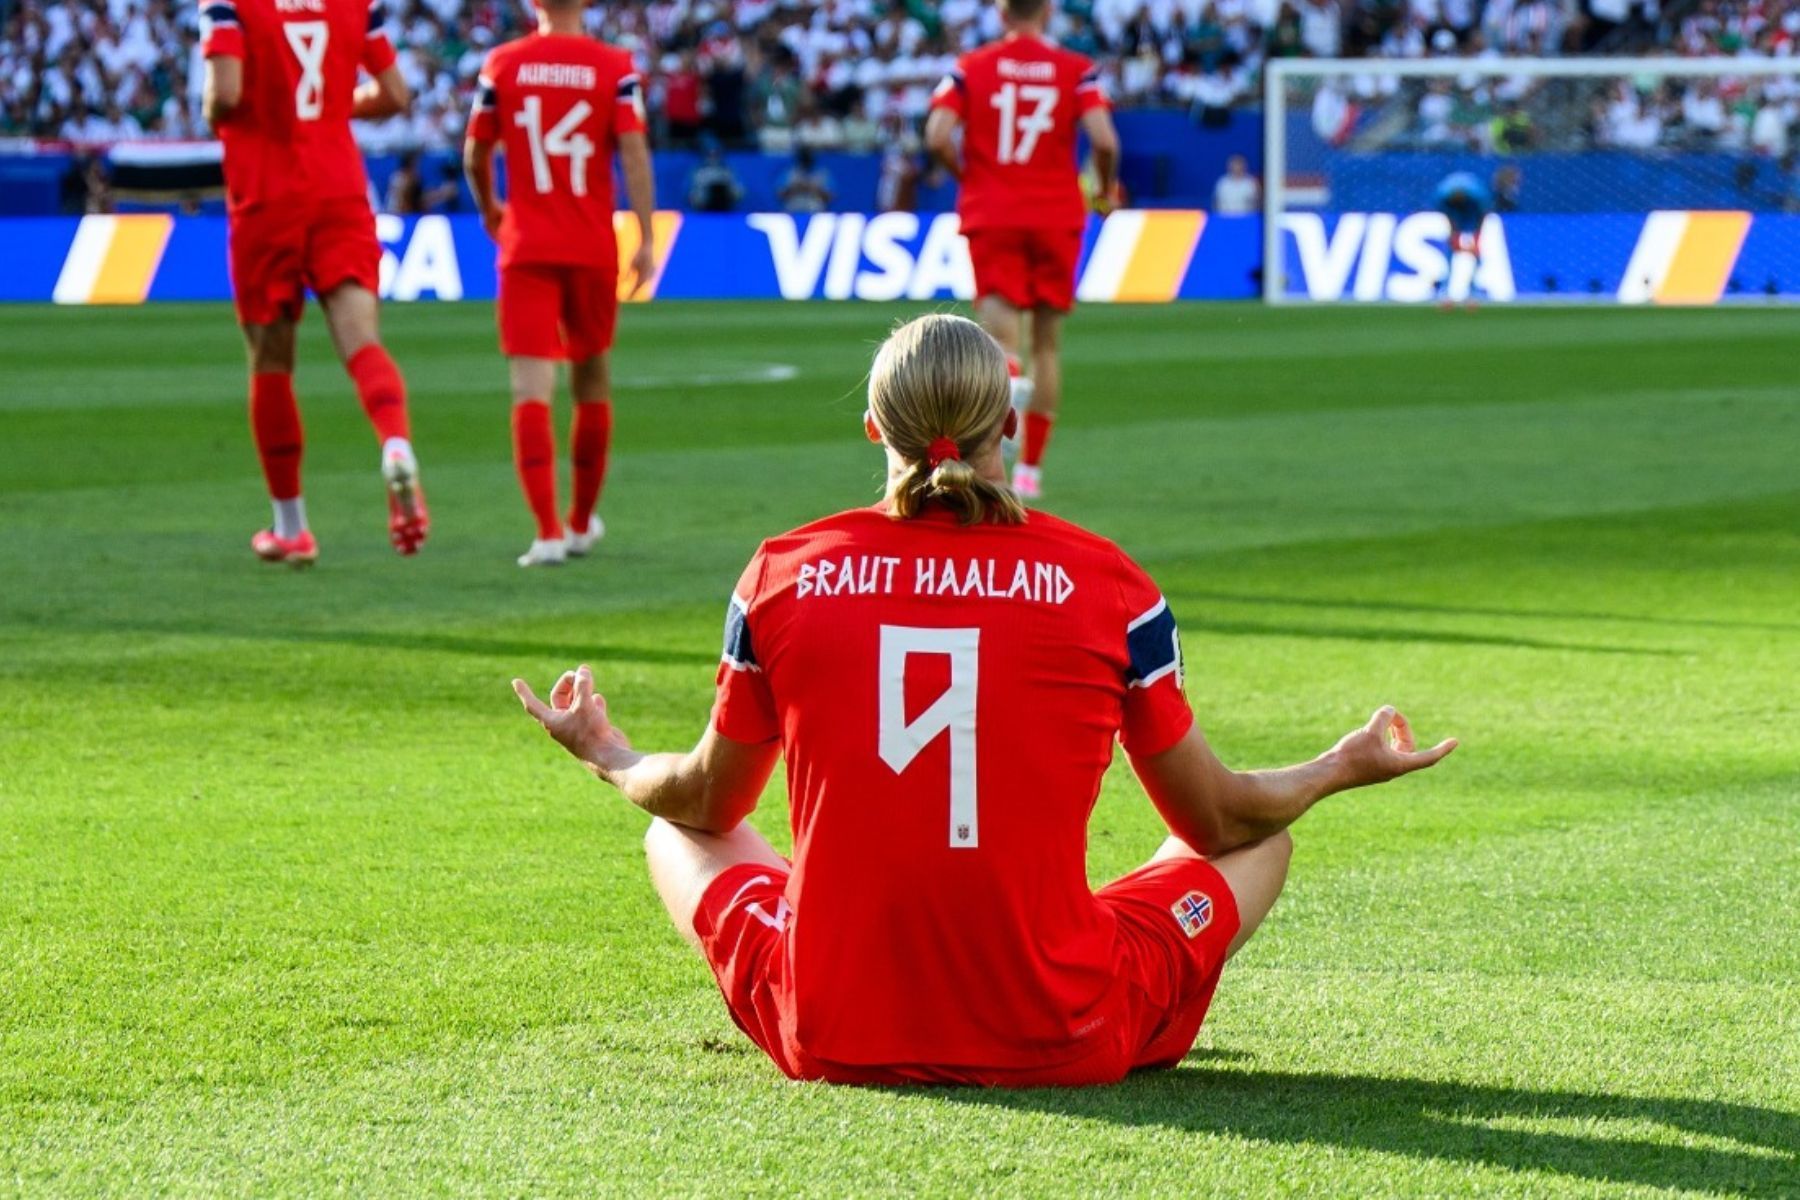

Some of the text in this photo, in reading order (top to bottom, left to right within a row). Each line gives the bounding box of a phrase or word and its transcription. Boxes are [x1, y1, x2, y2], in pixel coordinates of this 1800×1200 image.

[283, 20, 329, 121] 8
[514, 95, 595, 197] 14
[990, 82, 1060, 164] 17
[747, 211, 977, 301] VISA
[796, 555, 1076, 605] BRAUT HAALAND
[878, 624, 981, 848] 9
